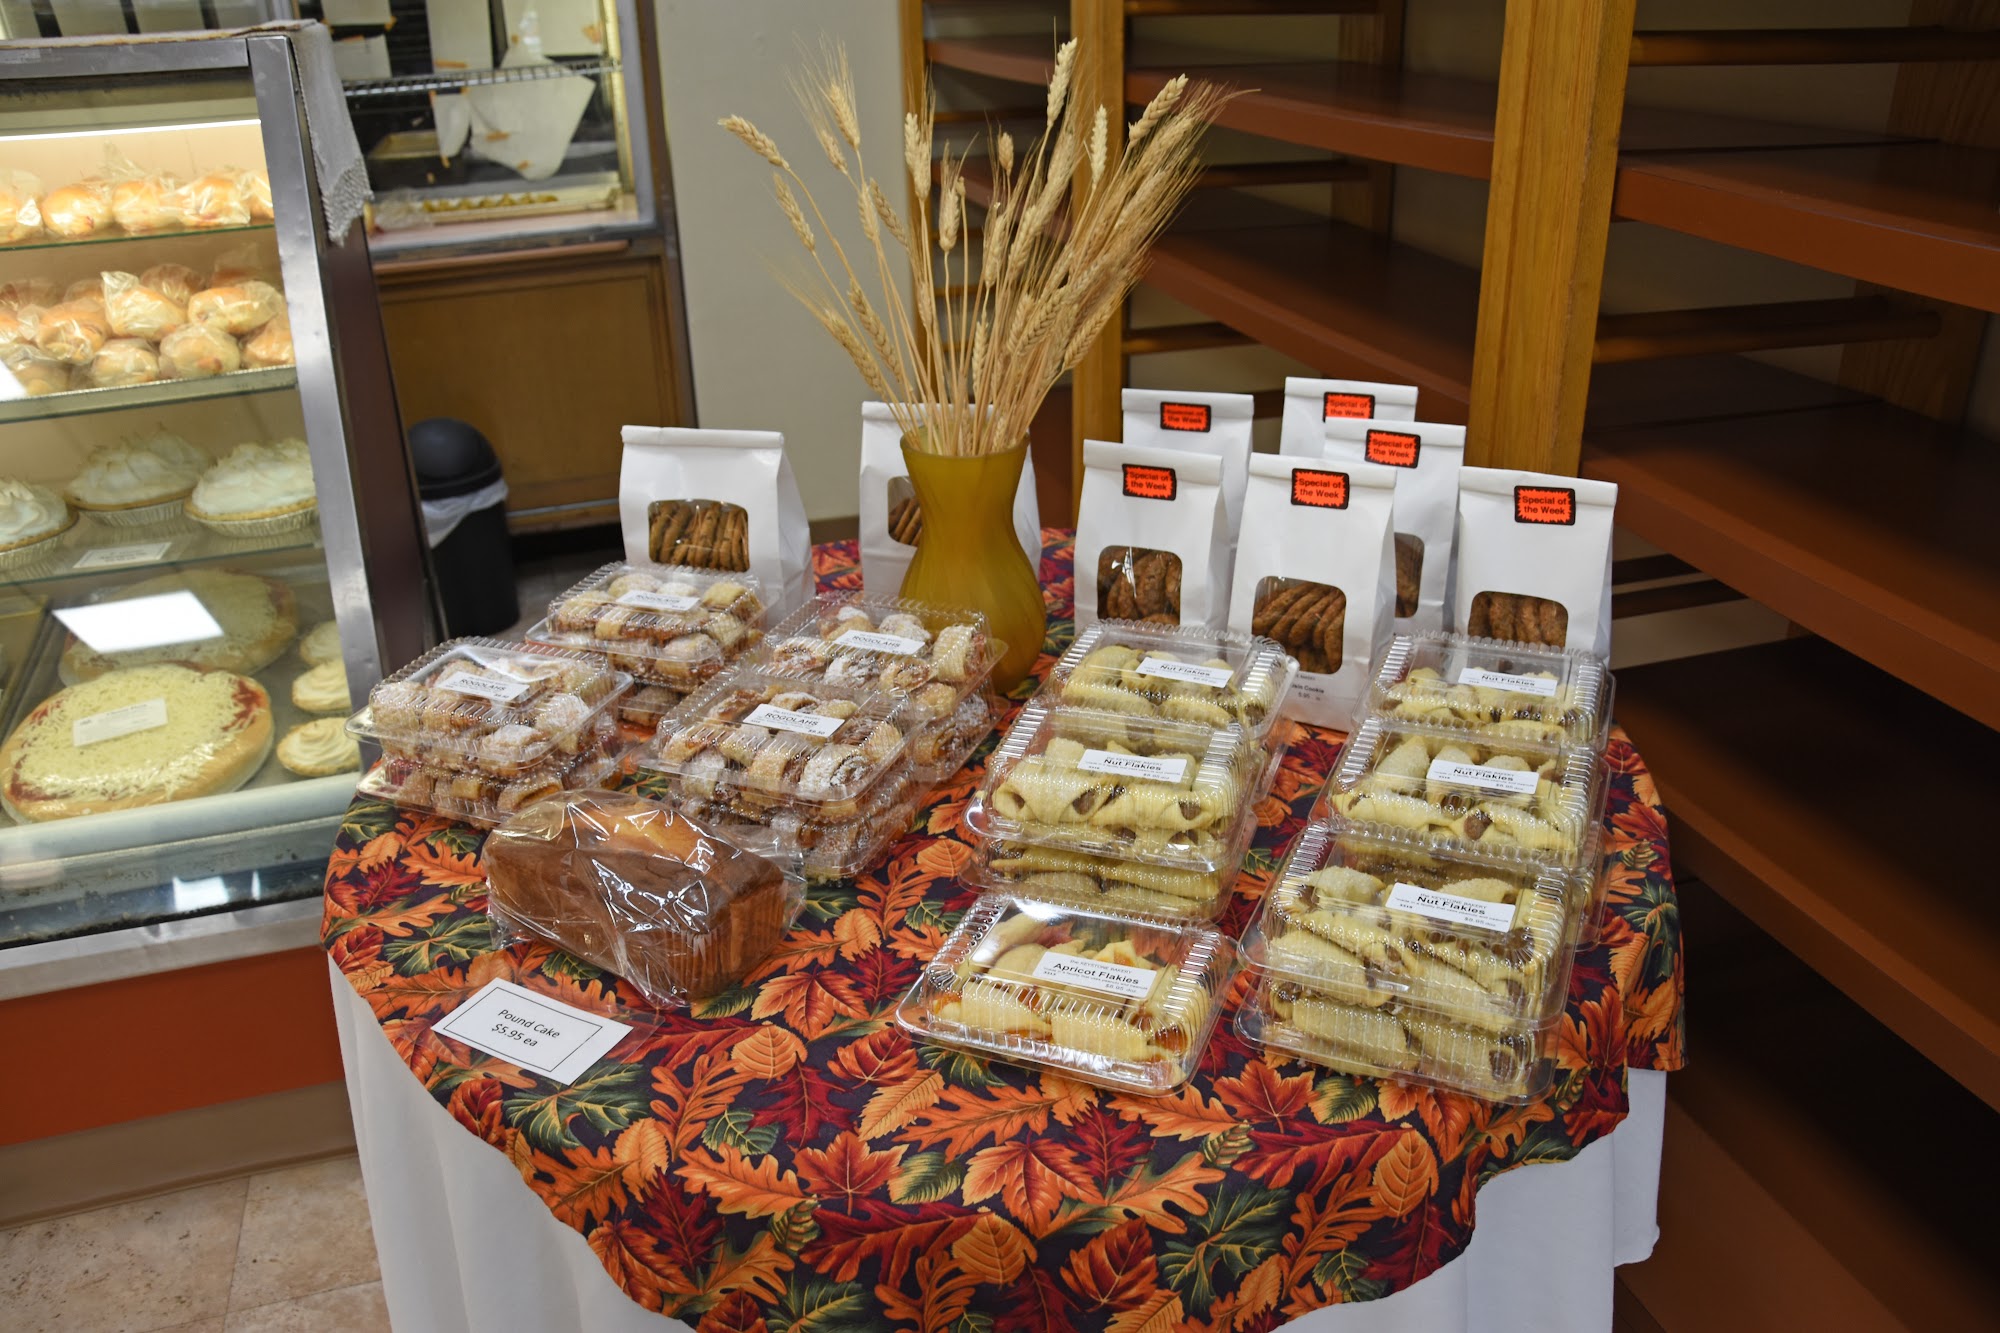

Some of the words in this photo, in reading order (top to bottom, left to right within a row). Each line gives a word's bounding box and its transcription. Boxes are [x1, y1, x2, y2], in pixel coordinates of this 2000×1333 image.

[1329, 399, 1358, 409] Special
[1330, 408, 1342, 416] the
[1344, 409, 1365, 418] Week
[1167, 415, 1181, 423] the
[1182, 416, 1203, 425] Week
[1372, 438, 1401, 449] Special
[1403, 441, 1413, 449] of
[1373, 448, 1387, 456] the
[1388, 449, 1410, 459] Week
[1129, 471, 1159, 482] Special
[1161, 474, 1169, 482] of
[1131, 480, 1144, 489] the
[1146, 482, 1167, 491] Week
[1299, 478, 1329, 490] Special
[1331, 481, 1342, 489] of
[1300, 488, 1313, 497] the
[1315, 489, 1339, 499] Week
[1522, 495, 1554, 506] Special
[1557, 497, 1567, 505] of
[1524, 505, 1538, 514] the
[1541, 506, 1565, 516] Week
[1178, 667, 1211, 677] Flakies
[1500, 678, 1535, 687] Flakies
[764, 712, 819, 726] ROGOLAHS
[1103, 758, 1122, 766] Nut
[1125, 761, 1161, 771] Flakies
[1453, 768, 1473, 776] Nut
[1475, 771, 1514, 782] Flakies
[1417, 896, 1438, 906] Nut
[1442, 900, 1486, 915] Flakies
[1053, 963, 1096, 977] Apricot
[1098, 971, 1139, 985] Flakies
[497, 1009, 535, 1029] Pound
[533, 1023, 561, 1039] Cake
[491, 1023, 523, 1042] $5.95
[523, 1036, 538, 1048] ea
